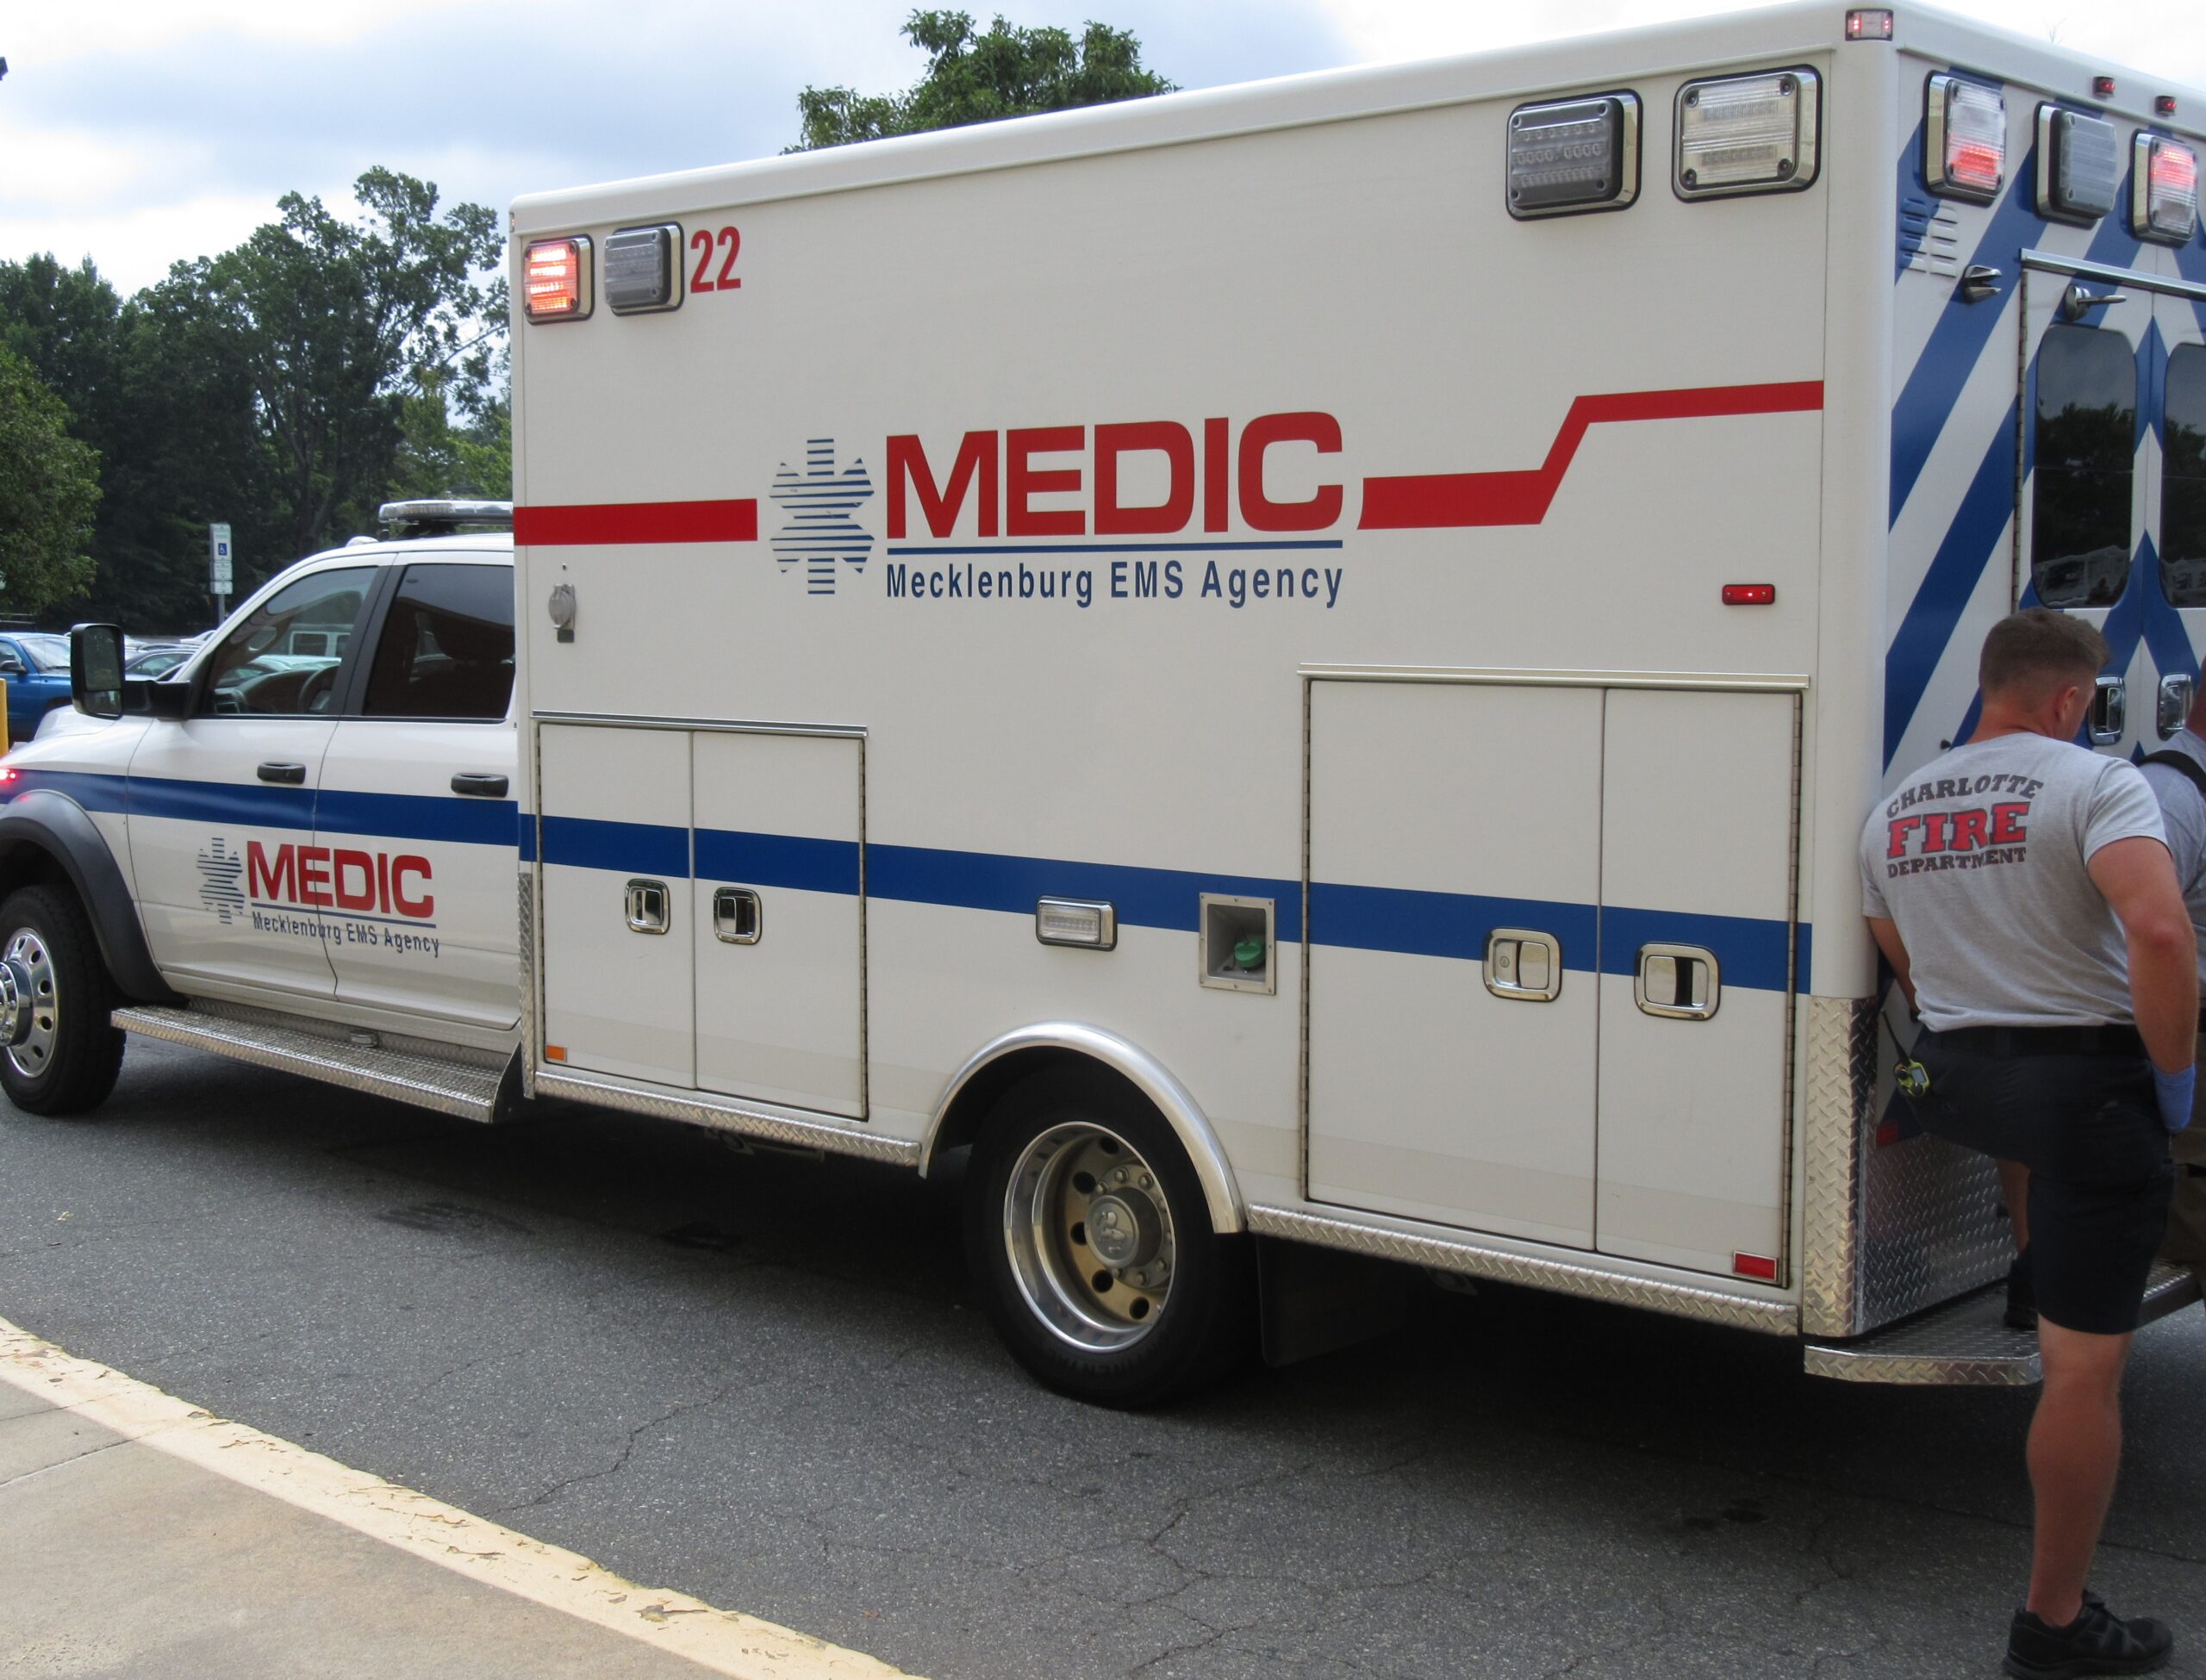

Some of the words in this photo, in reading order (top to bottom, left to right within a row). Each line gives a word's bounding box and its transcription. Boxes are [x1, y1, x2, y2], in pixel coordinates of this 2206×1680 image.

[690, 226, 741, 293] 22
[886, 411, 1343, 539] MEDIC
[886, 563, 1093, 608] Mecklenburg
[1110, 560, 1184, 598] EMS
[1200, 560, 1343, 609] Agency
[1886, 774, 2044, 818] CHARLOTTE
[1886, 801, 2031, 860] FIRE
[246, 840, 434, 918] MEDIC
[1886, 847, 2027, 879] DEPARTMENT
[252, 911, 341, 945] Mecklenburg
[346, 922, 378, 946] EMS
[384, 927, 440, 958] Agency
